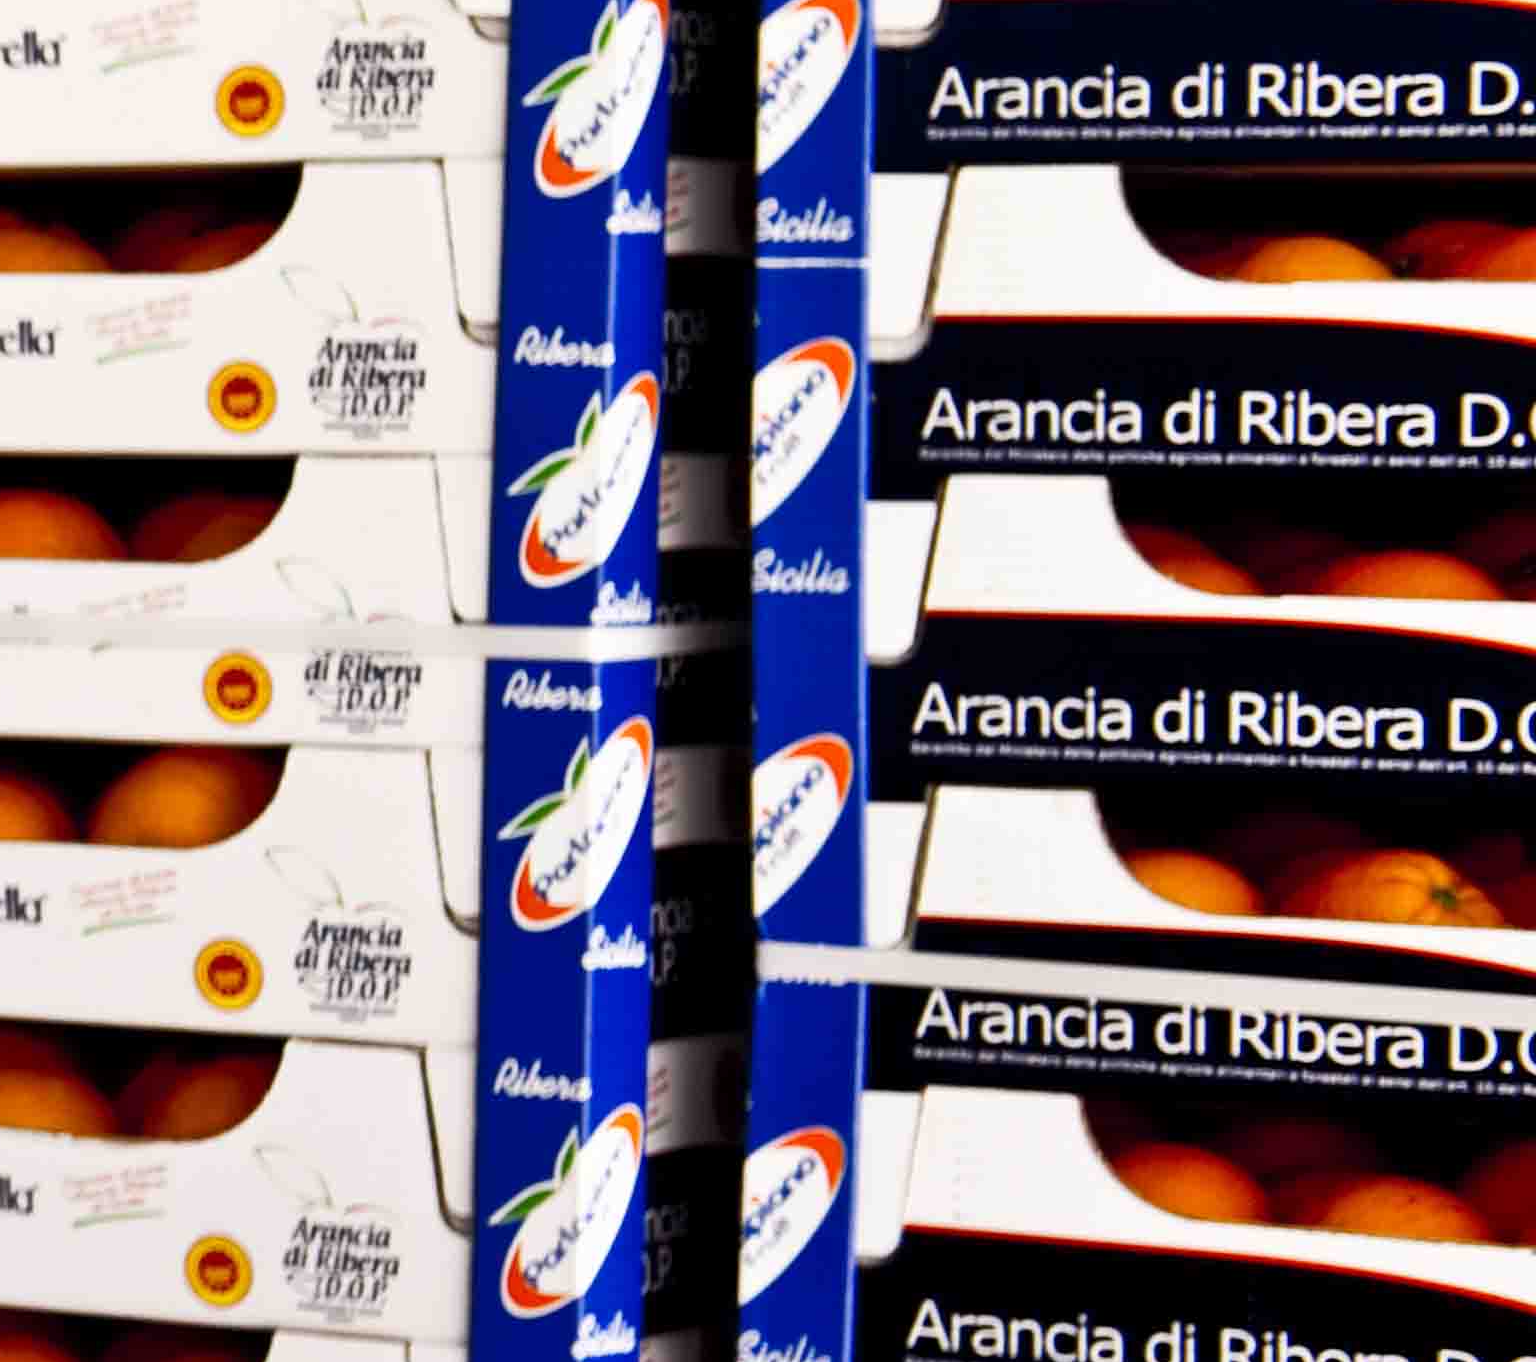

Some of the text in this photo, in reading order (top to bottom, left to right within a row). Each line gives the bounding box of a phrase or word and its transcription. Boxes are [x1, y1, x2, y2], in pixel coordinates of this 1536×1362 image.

[930, 60, 1444, 120] Arancia di Ribera
[756, 198, 853, 244] Sicilia
[317, 337, 416, 364] Arancia
[514, 326, 615, 368] Ribera
[308, 364, 426, 389] di Ribera
[751, 547, 850, 595] Sicilia
[502, 669, 603, 712] Ribera
[913, 682, 1424, 751] Arancia di Ribera
[303, 918, 403, 947] Arancia
[295, 947, 412, 976] di Ribera
[916, 987, 1425, 1069] Arancia di Ribera
[492, 1057, 592, 1102] Ribera
